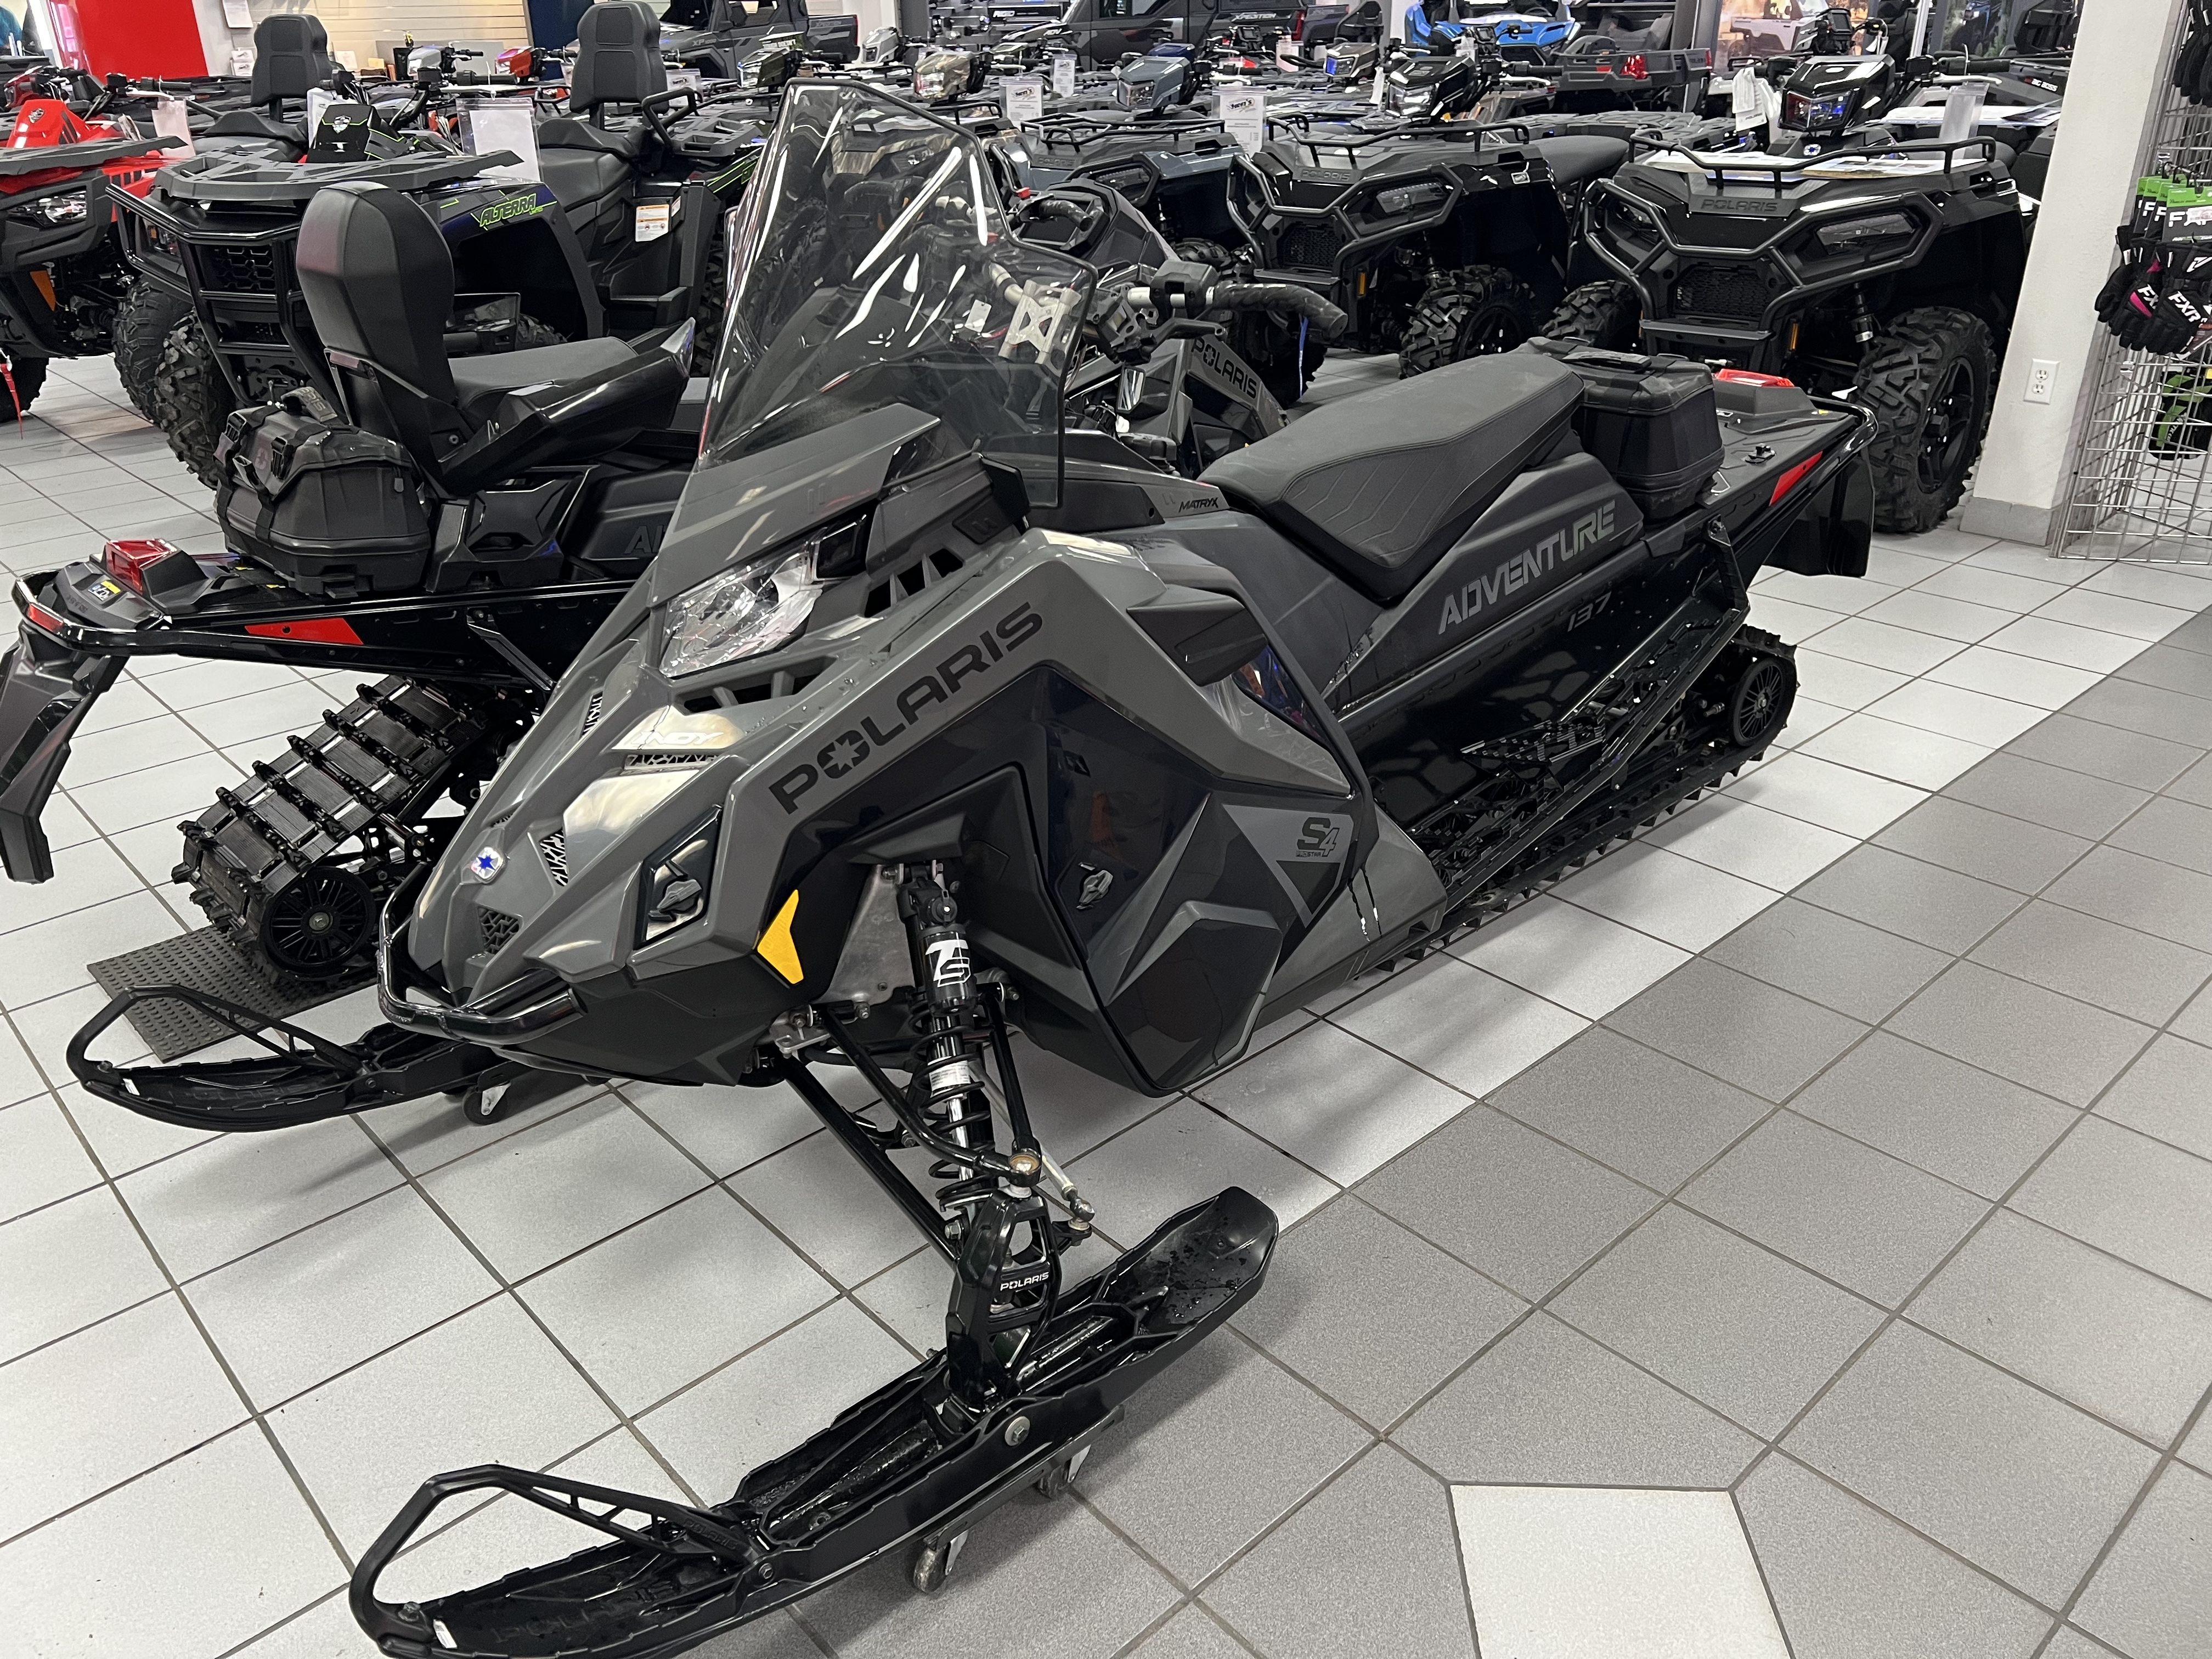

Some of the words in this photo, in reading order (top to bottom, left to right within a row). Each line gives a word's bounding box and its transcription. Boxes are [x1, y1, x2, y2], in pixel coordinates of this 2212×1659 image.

[1300, 169, 1351, 182] POLARIS
[479, 193, 537, 227] ALTERRA
[1701, 199, 1778, 212] POLARIS
[2137, 283, 2159, 310] FX
[1191, 336, 1257, 399] POLARIS
[1178, 496, 1219, 513] MATRYX
[1438, 499, 1615, 635] ADVENTURE
[1567, 590, 1612, 631] 137
[768, 601, 1043, 815] POLARIS
[630, 731, 724, 744] INDY
[1000, 1272, 1049, 1291] POLARIS
